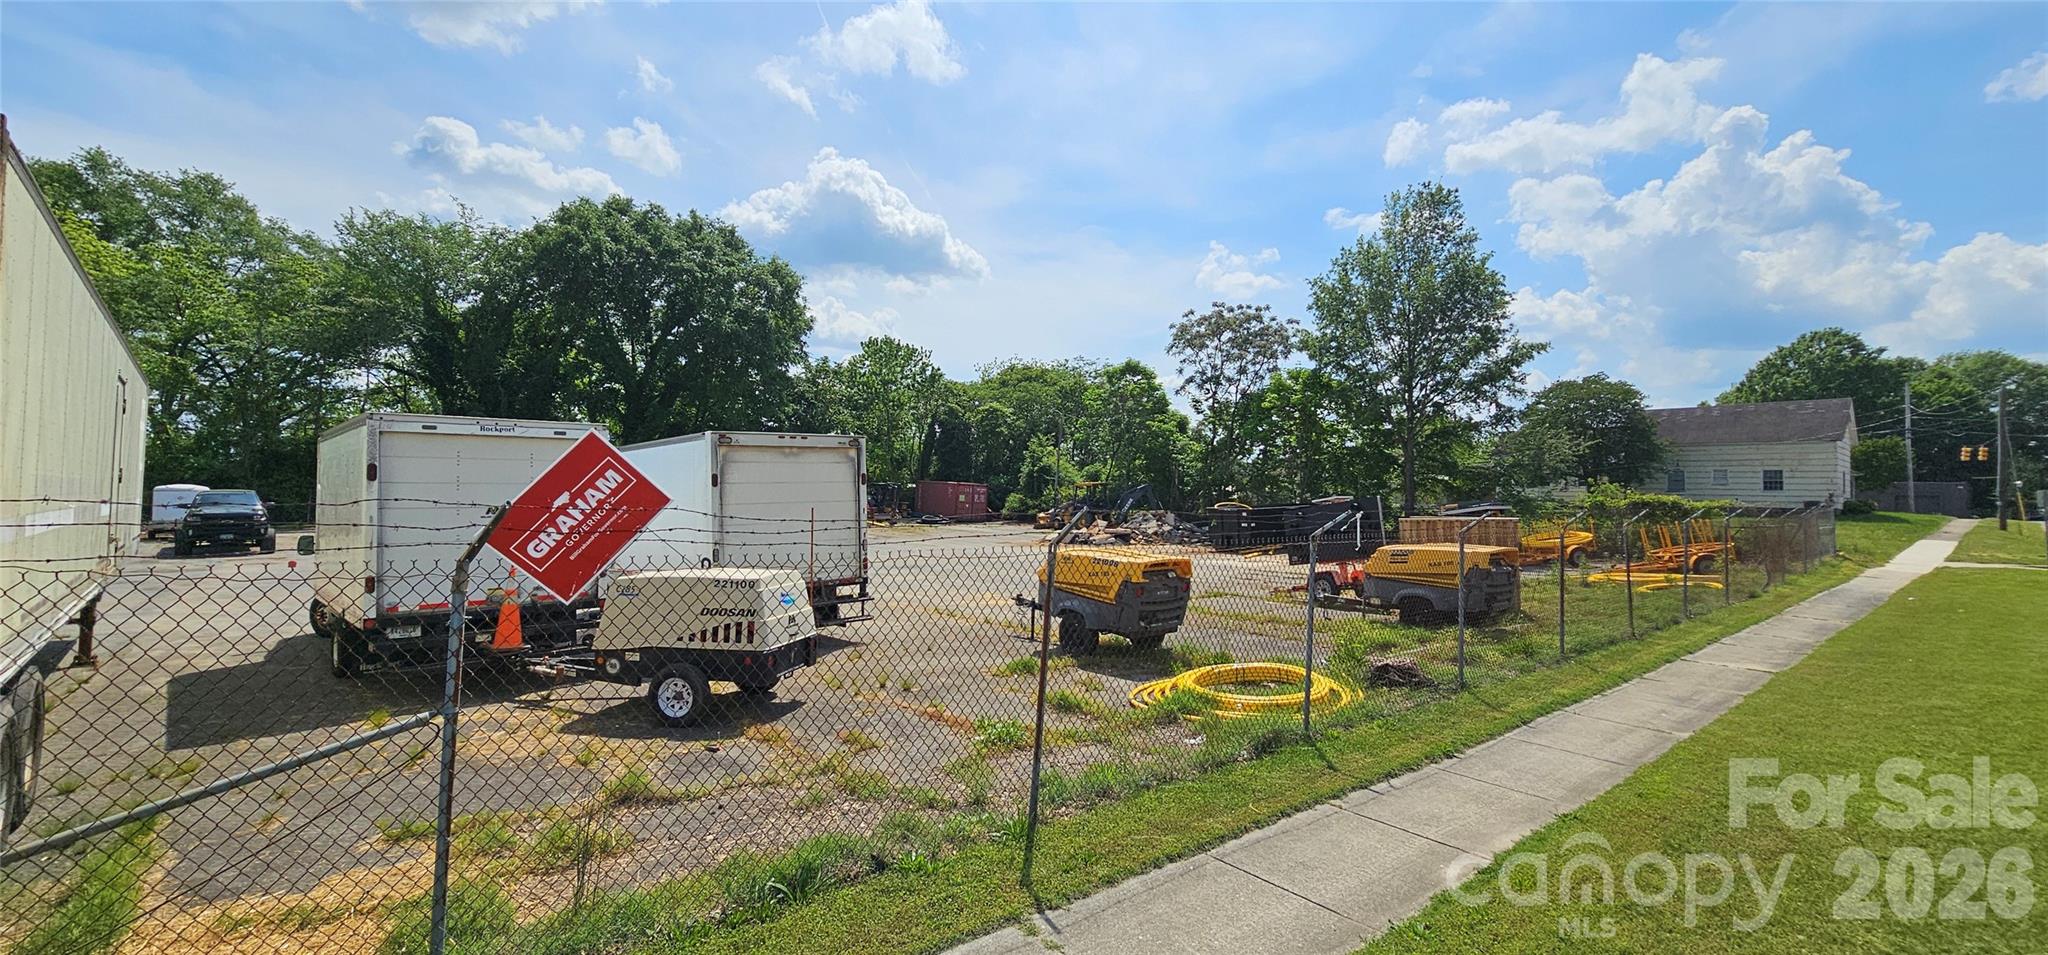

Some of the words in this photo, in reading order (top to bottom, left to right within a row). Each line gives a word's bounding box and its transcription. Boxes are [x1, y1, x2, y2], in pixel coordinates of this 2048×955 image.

[480, 425, 516, 433] Rockport
[526, 468, 624, 558] GRAHAM
[565, 502, 613, 547] GOVERNOR
[713, 579, 756, 589] 221100
[700, 607, 758, 618] DOOSAN
